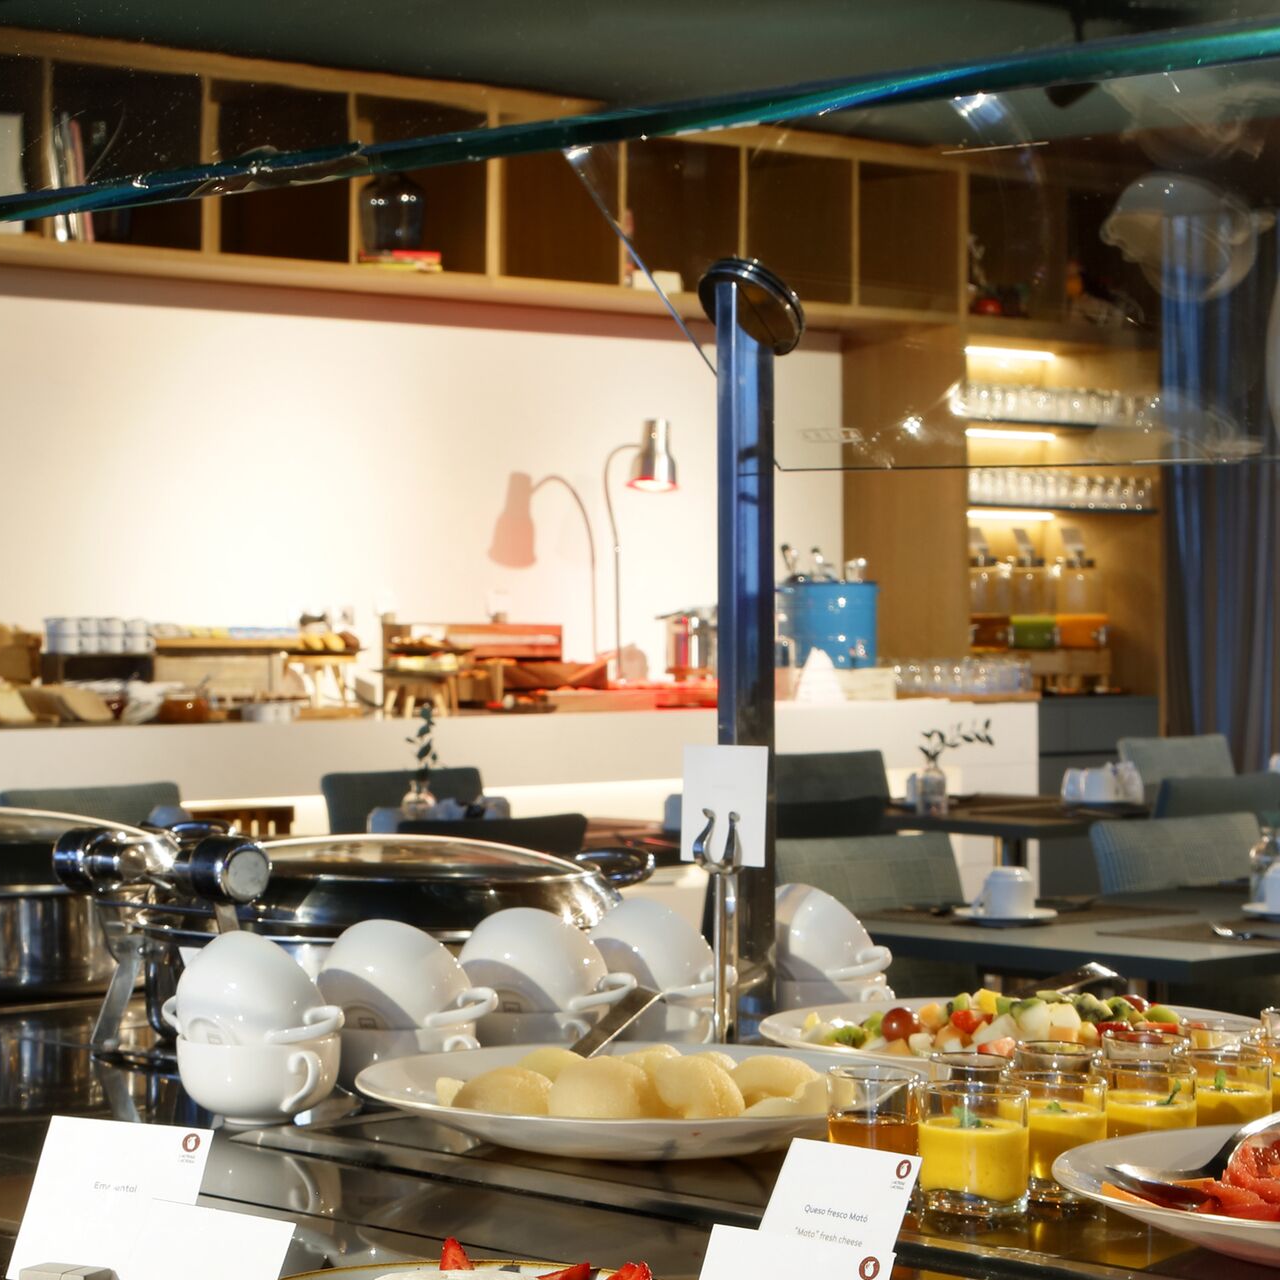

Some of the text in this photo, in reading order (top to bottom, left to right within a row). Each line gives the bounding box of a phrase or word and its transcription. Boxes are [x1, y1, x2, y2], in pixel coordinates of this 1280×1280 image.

[804, 1204, 869, 1223] Queso fresco Mató
[820, 1231, 837, 1243] fresh
[838, 1235, 863, 1248] cheese
